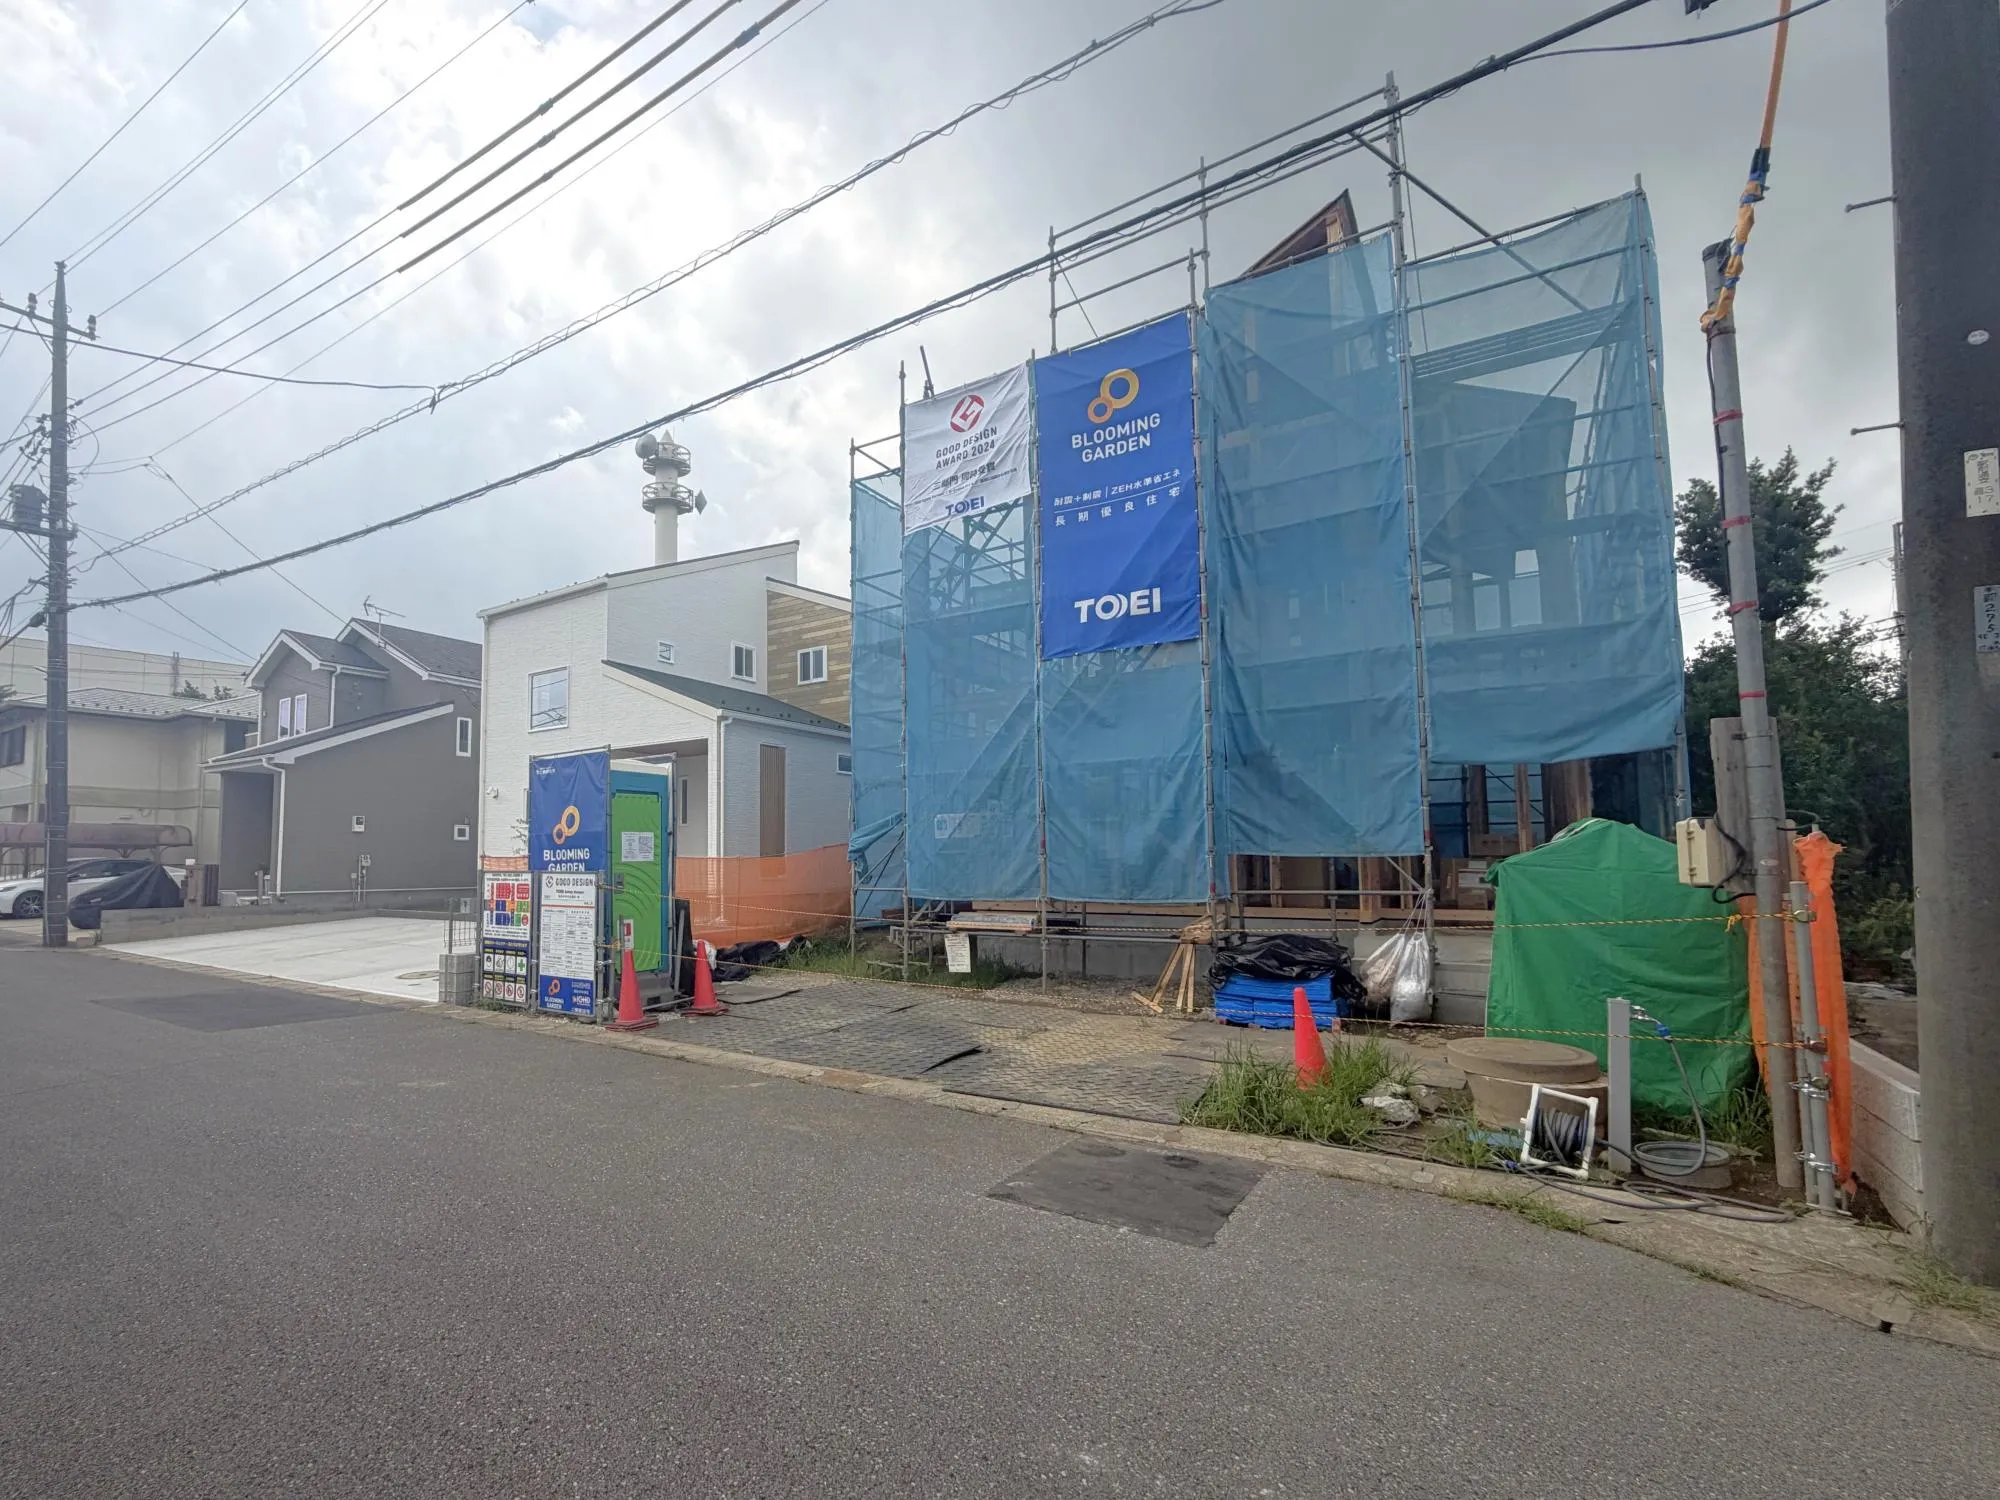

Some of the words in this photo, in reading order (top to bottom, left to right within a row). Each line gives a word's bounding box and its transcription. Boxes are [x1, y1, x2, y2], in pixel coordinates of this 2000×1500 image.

[936, 442, 961, 459] GOOD
[963, 426, 998, 449] DESIGN
[1071, 413, 1161, 449] BLOOMING
[936, 449, 968, 470] AWARD
[971, 440, 995, 457] 2024
[1081, 433, 1151, 463] GARDEN
[945, 496, 985, 516] TOEI
[1055, 486, 1181, 527] 長期優良住宅
[1074, 587, 1161, 623] TOEI
[543, 848, 590, 861] BLOOMING
[548, 862, 585, 872] GARDEN
[555, 877, 571, 886] GOOD
[572, 877, 594, 887] DESIGN
